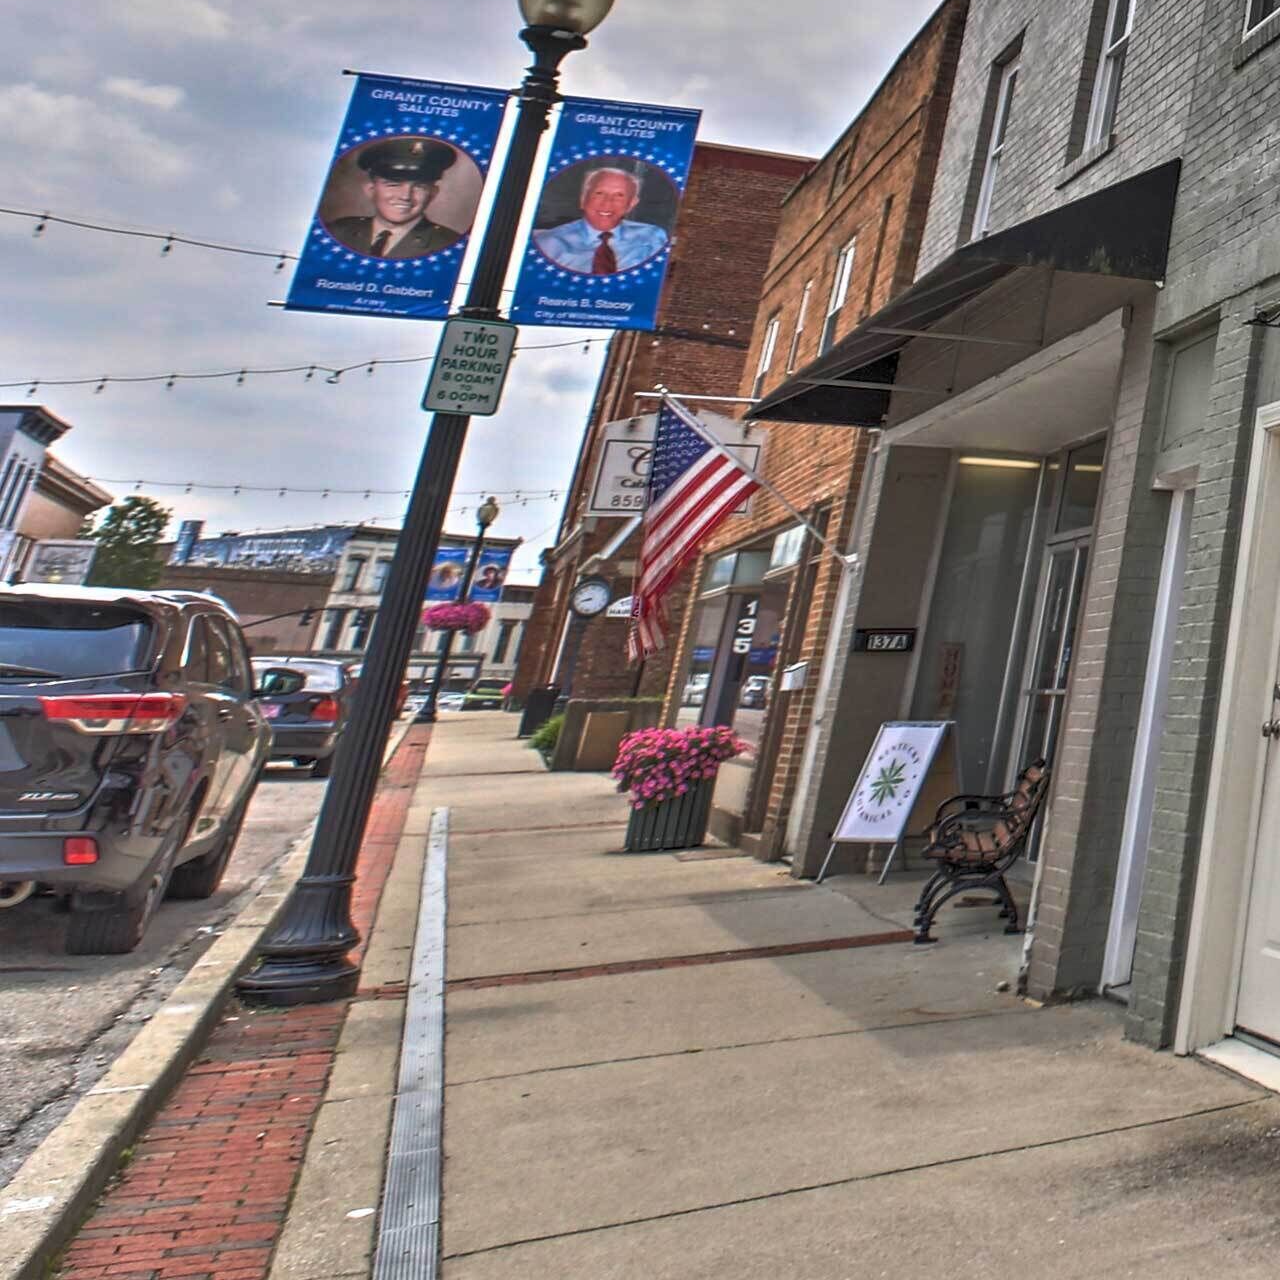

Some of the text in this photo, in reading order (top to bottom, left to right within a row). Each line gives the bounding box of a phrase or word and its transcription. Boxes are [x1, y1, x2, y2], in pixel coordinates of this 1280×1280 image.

[371, 89, 492, 111] GRANT COUNTY
[398, 103, 460, 117] SALUTES
[575, 113, 686, 132] GRANT COUNTY
[600, 126, 656, 139] SALUTES
[316, 278, 433, 298] Ronald D. Gabbert
[354, 297, 386, 308] Army
[538, 296, 577, 308] Reavis
[534, 310, 554, 320] City
[557, 311, 568, 320] of
[463, 331, 498, 345] TWO
[453, 344, 498, 359] HOUR
[441, 358, 503, 374] PARKING
[733, 600, 758, 654] 135
[867, 634, 908, 650] 137A
